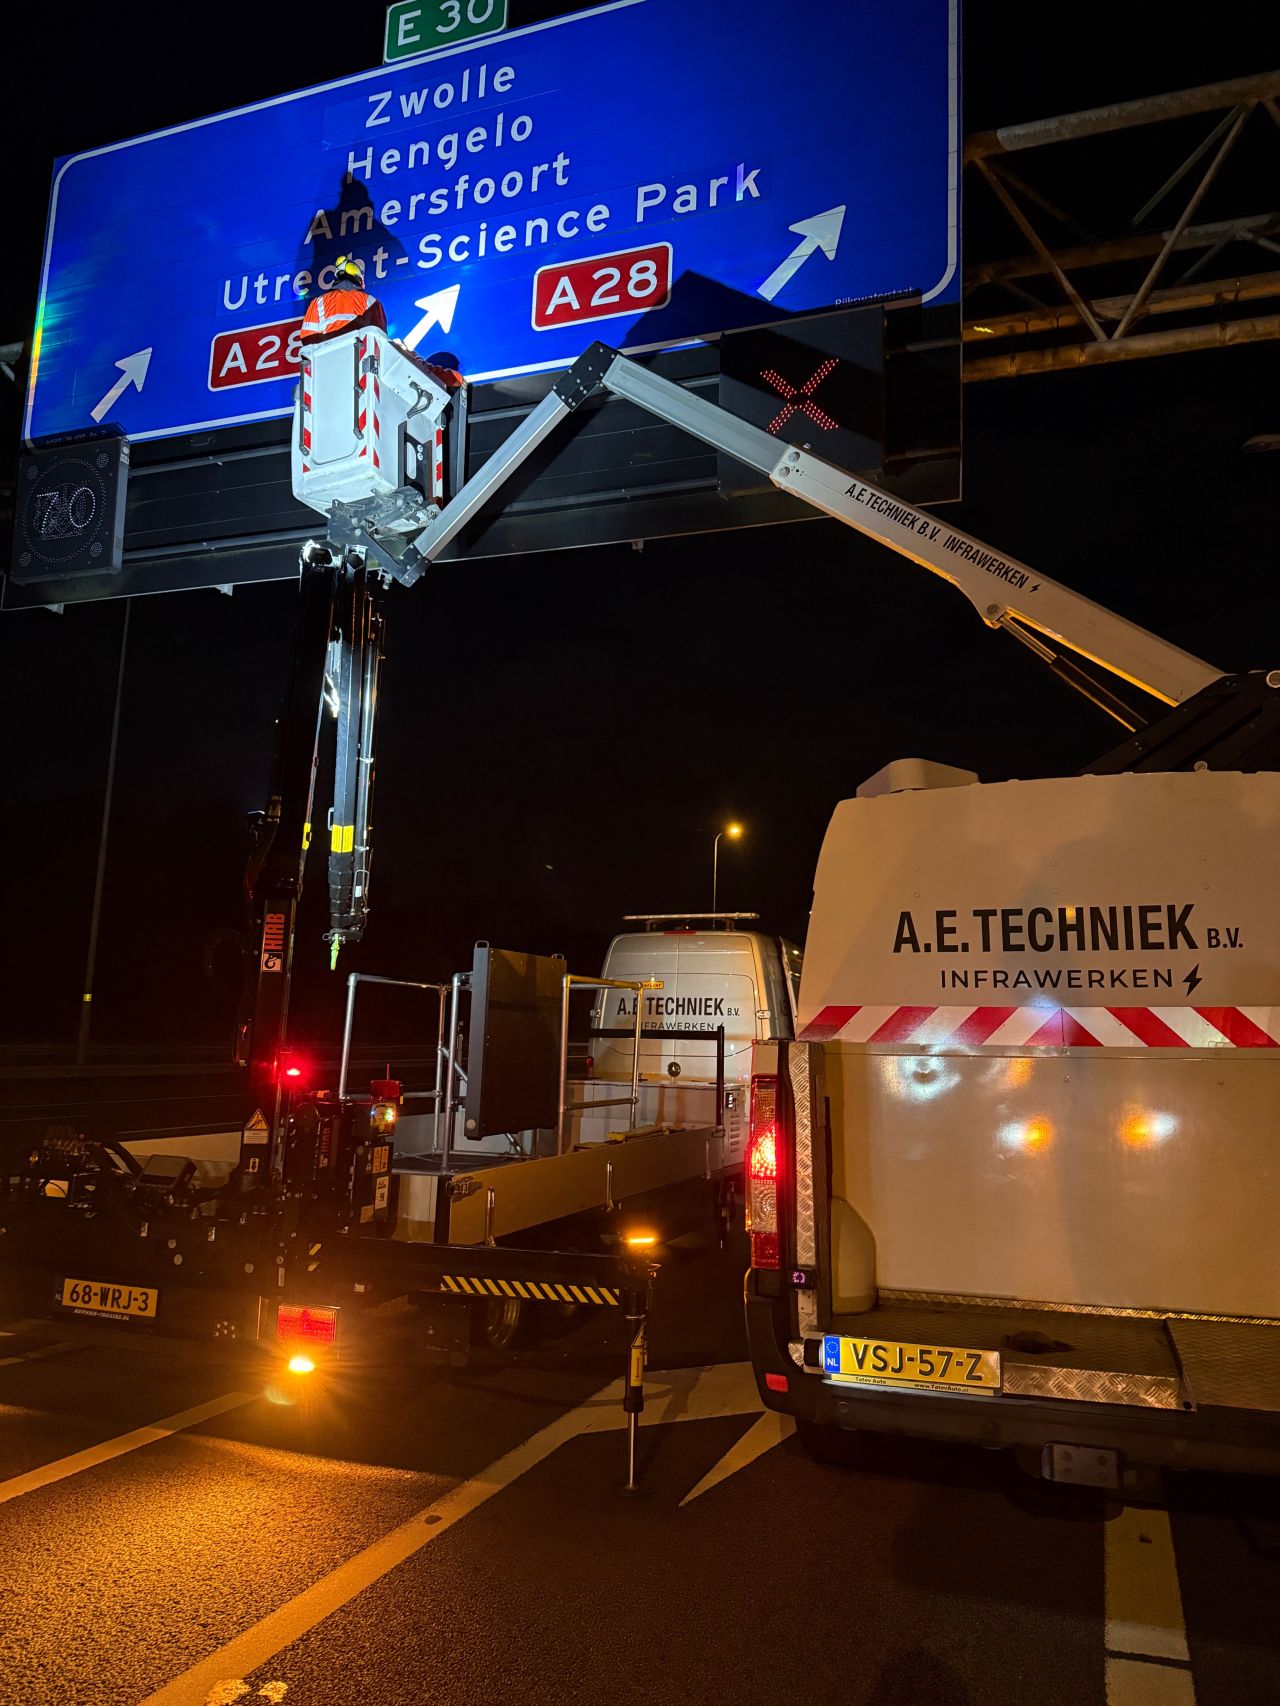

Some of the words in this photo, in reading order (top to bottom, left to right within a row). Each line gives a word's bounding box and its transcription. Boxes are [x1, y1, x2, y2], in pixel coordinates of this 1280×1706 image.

[396, 9, 421, 46] E
[436, 0, 495, 36] 30
[365, 64, 515, 129] Zwolle
[346, 114, 533, 184] Hengelo
[304, 151, 570, 244] Amersfoort
[636, 162, 762, 223] Park
[36, 487, 96, 533] 70
[845, 483, 922, 531] A.E.TECHNIEK
[916, 521, 941, 542] B.V.
[943, 535, 1029, 589] INFRAWERKEN
[264, 913, 285, 950] HIAB
[893, 904, 1199, 953] A.E.TECHNIEK
[1207, 927, 1244, 949] B.V.
[941, 968, 1173, 989] INFRAWERKEN
[727, 1007, 740, 1017] B.V.
[69, 1283, 149, 1312] 68-WRJ-3
[827, 1358, 839, 1367] NL
[850, 1343, 983, 1381] VSJ-57-Z
